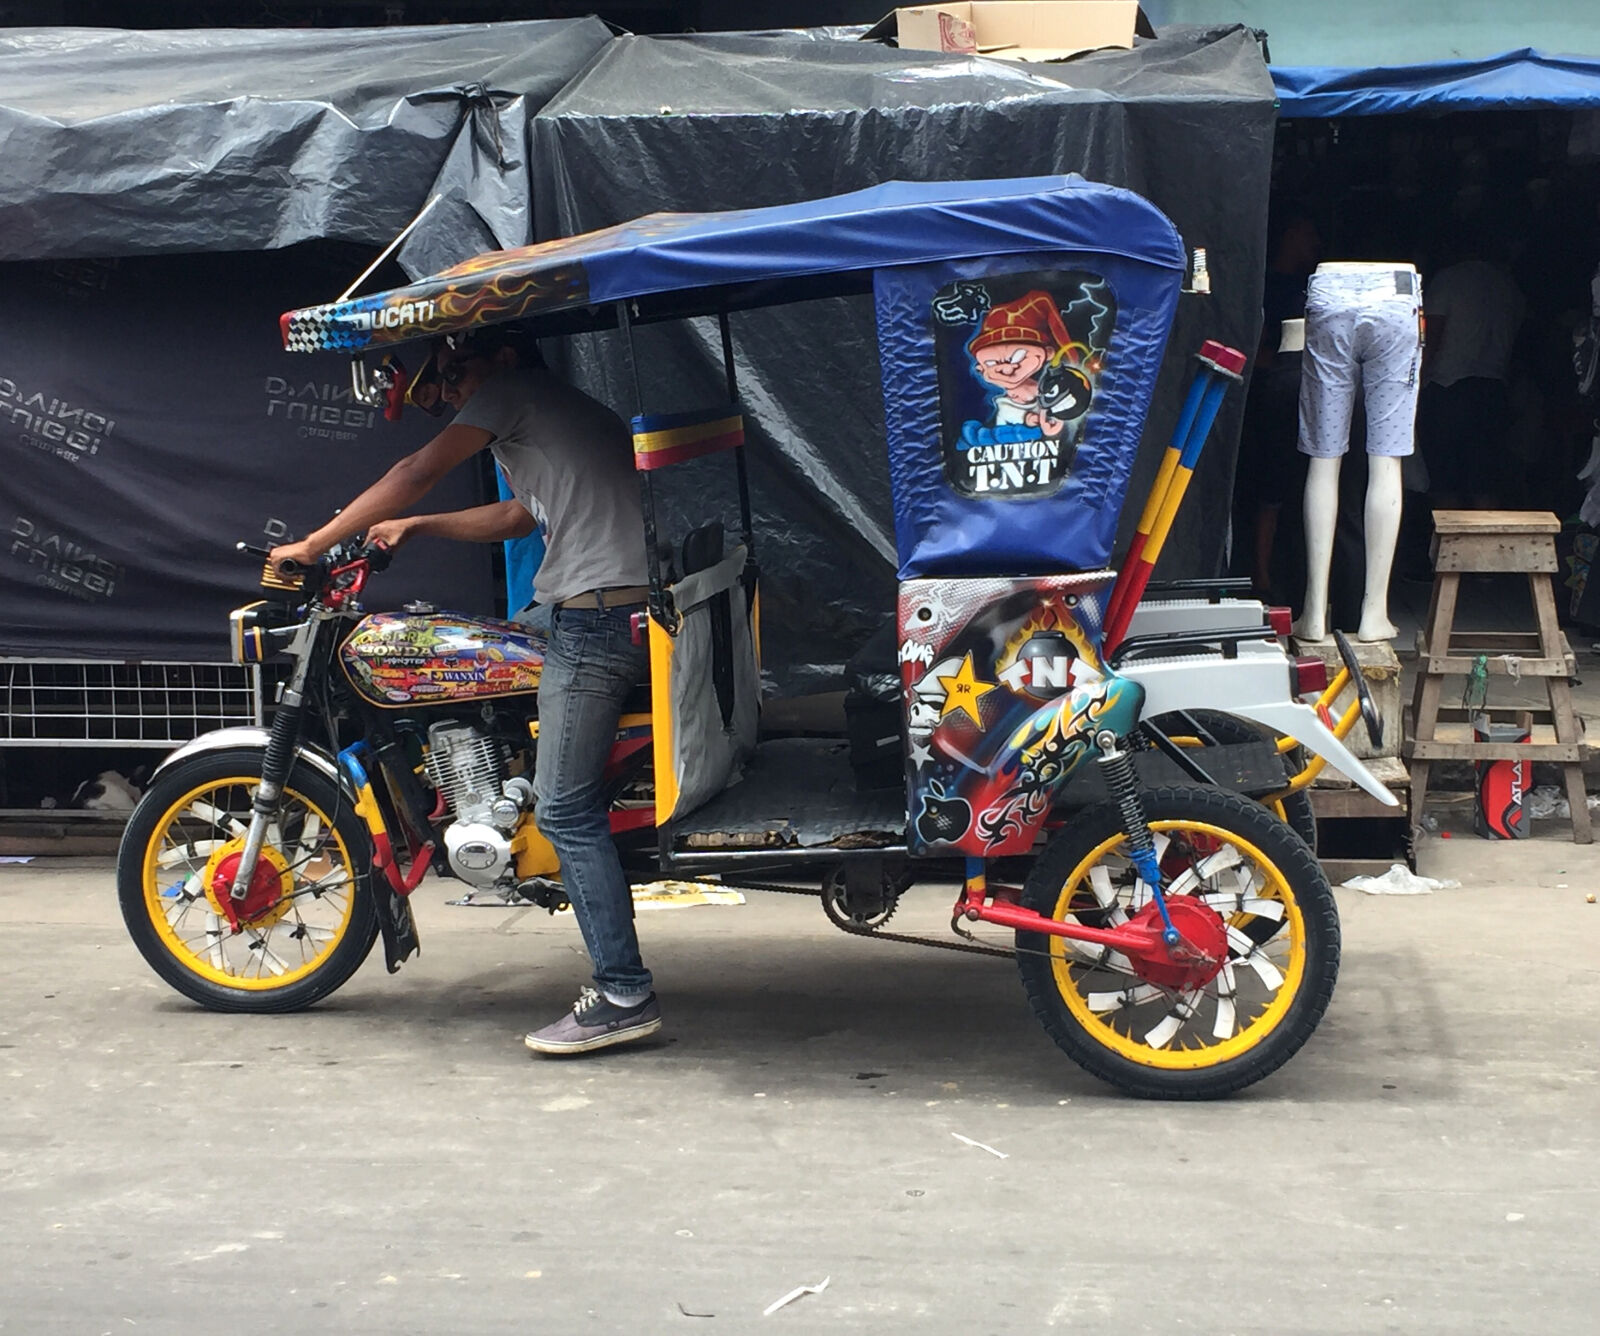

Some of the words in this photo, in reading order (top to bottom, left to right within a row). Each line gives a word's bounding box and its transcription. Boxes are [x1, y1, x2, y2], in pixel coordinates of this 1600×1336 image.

[967, 439, 1060, 464] CAUTION
[969, 458, 1058, 492] T.N.T
[443, 671, 486, 682] WANXIN
[998, 656, 1105, 693] TNT
